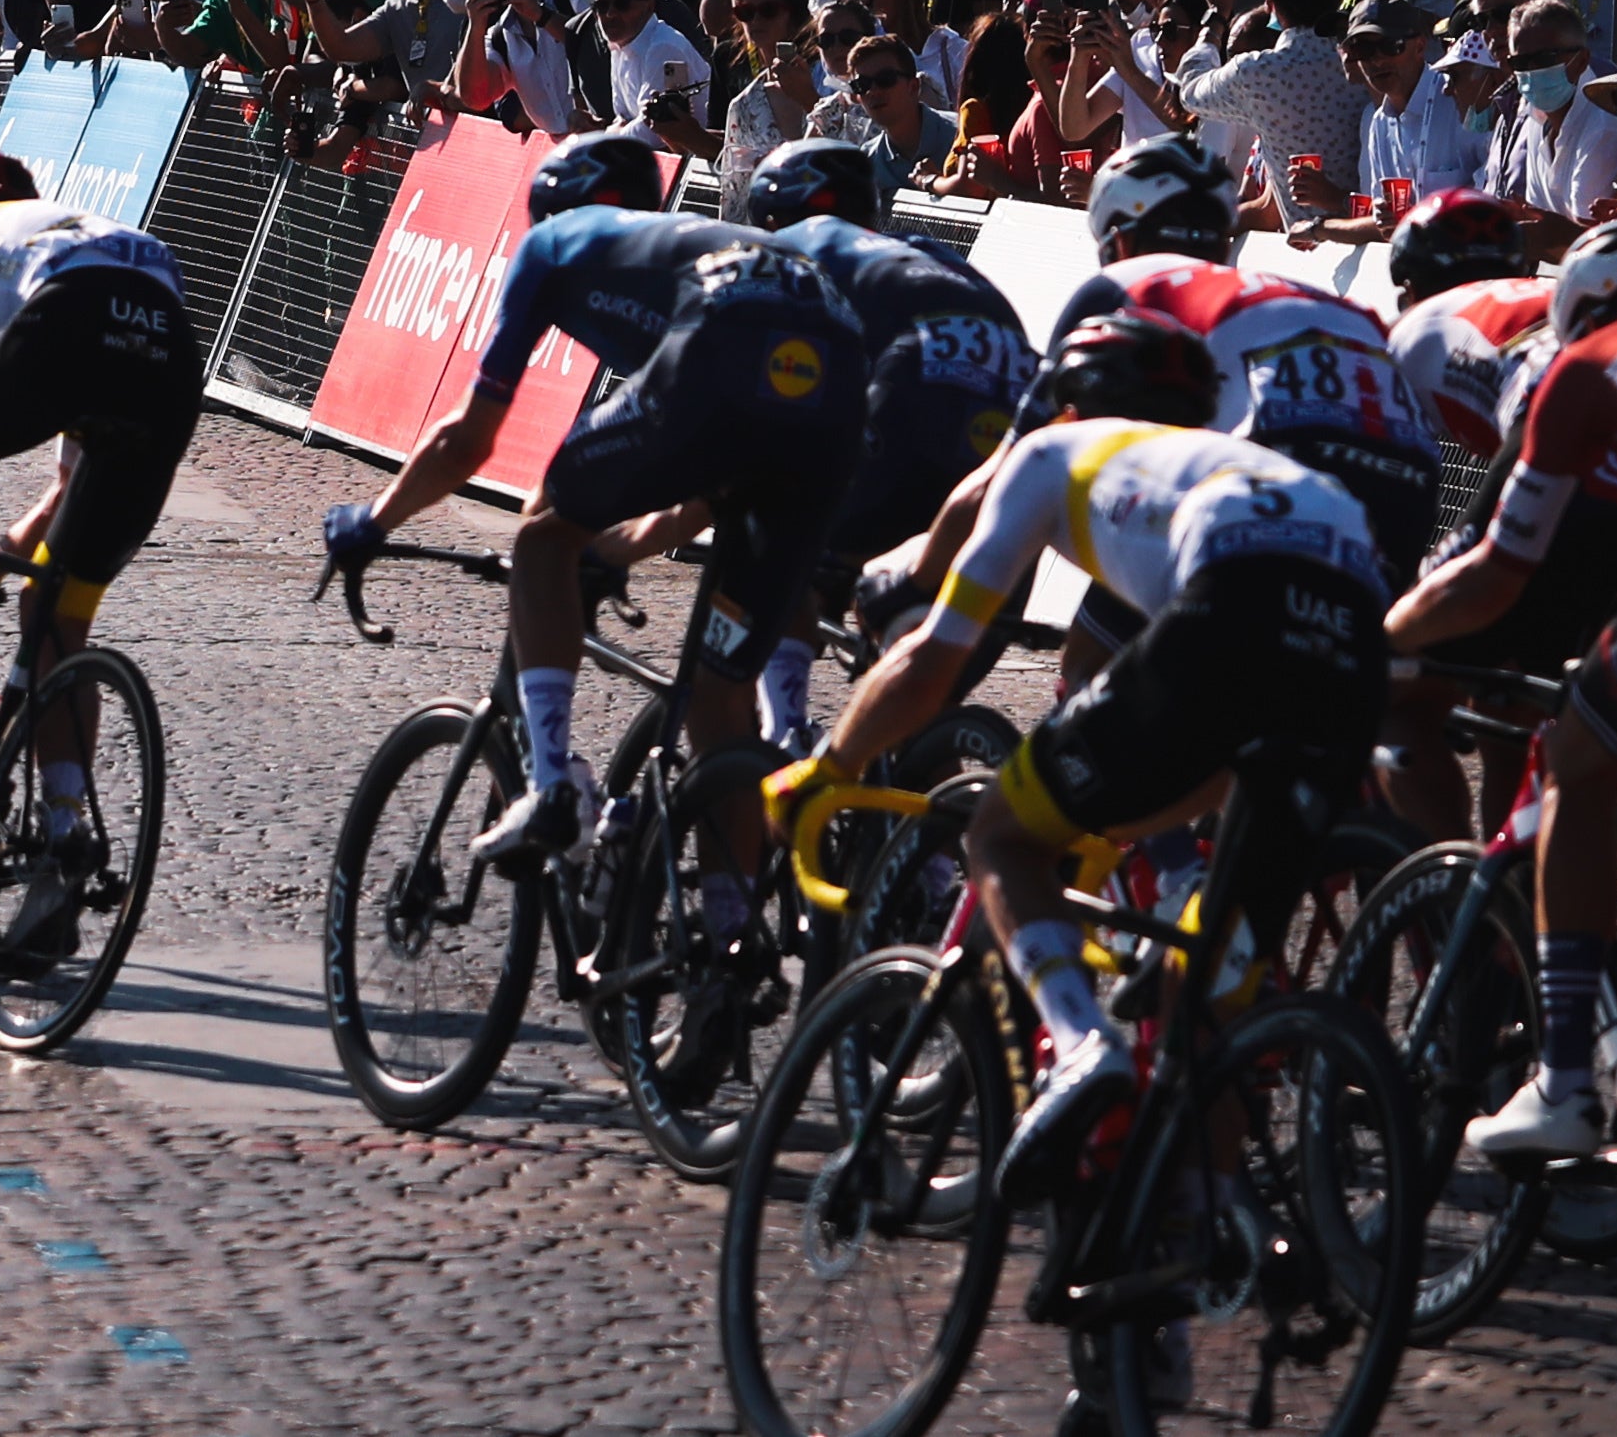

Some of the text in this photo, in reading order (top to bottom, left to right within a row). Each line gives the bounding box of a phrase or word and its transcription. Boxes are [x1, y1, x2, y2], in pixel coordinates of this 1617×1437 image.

[110, 295, 169, 334] UAE
[587, 290, 671, 334] QUICK-ST
[930, 315, 992, 365] 53
[1272, 345, 1344, 400] 48
[1317, 440, 1429, 486] TREK
[1284, 581, 1354, 642] UAE
[953, 727, 1004, 765] rov
[326, 864, 349, 1026] roval
